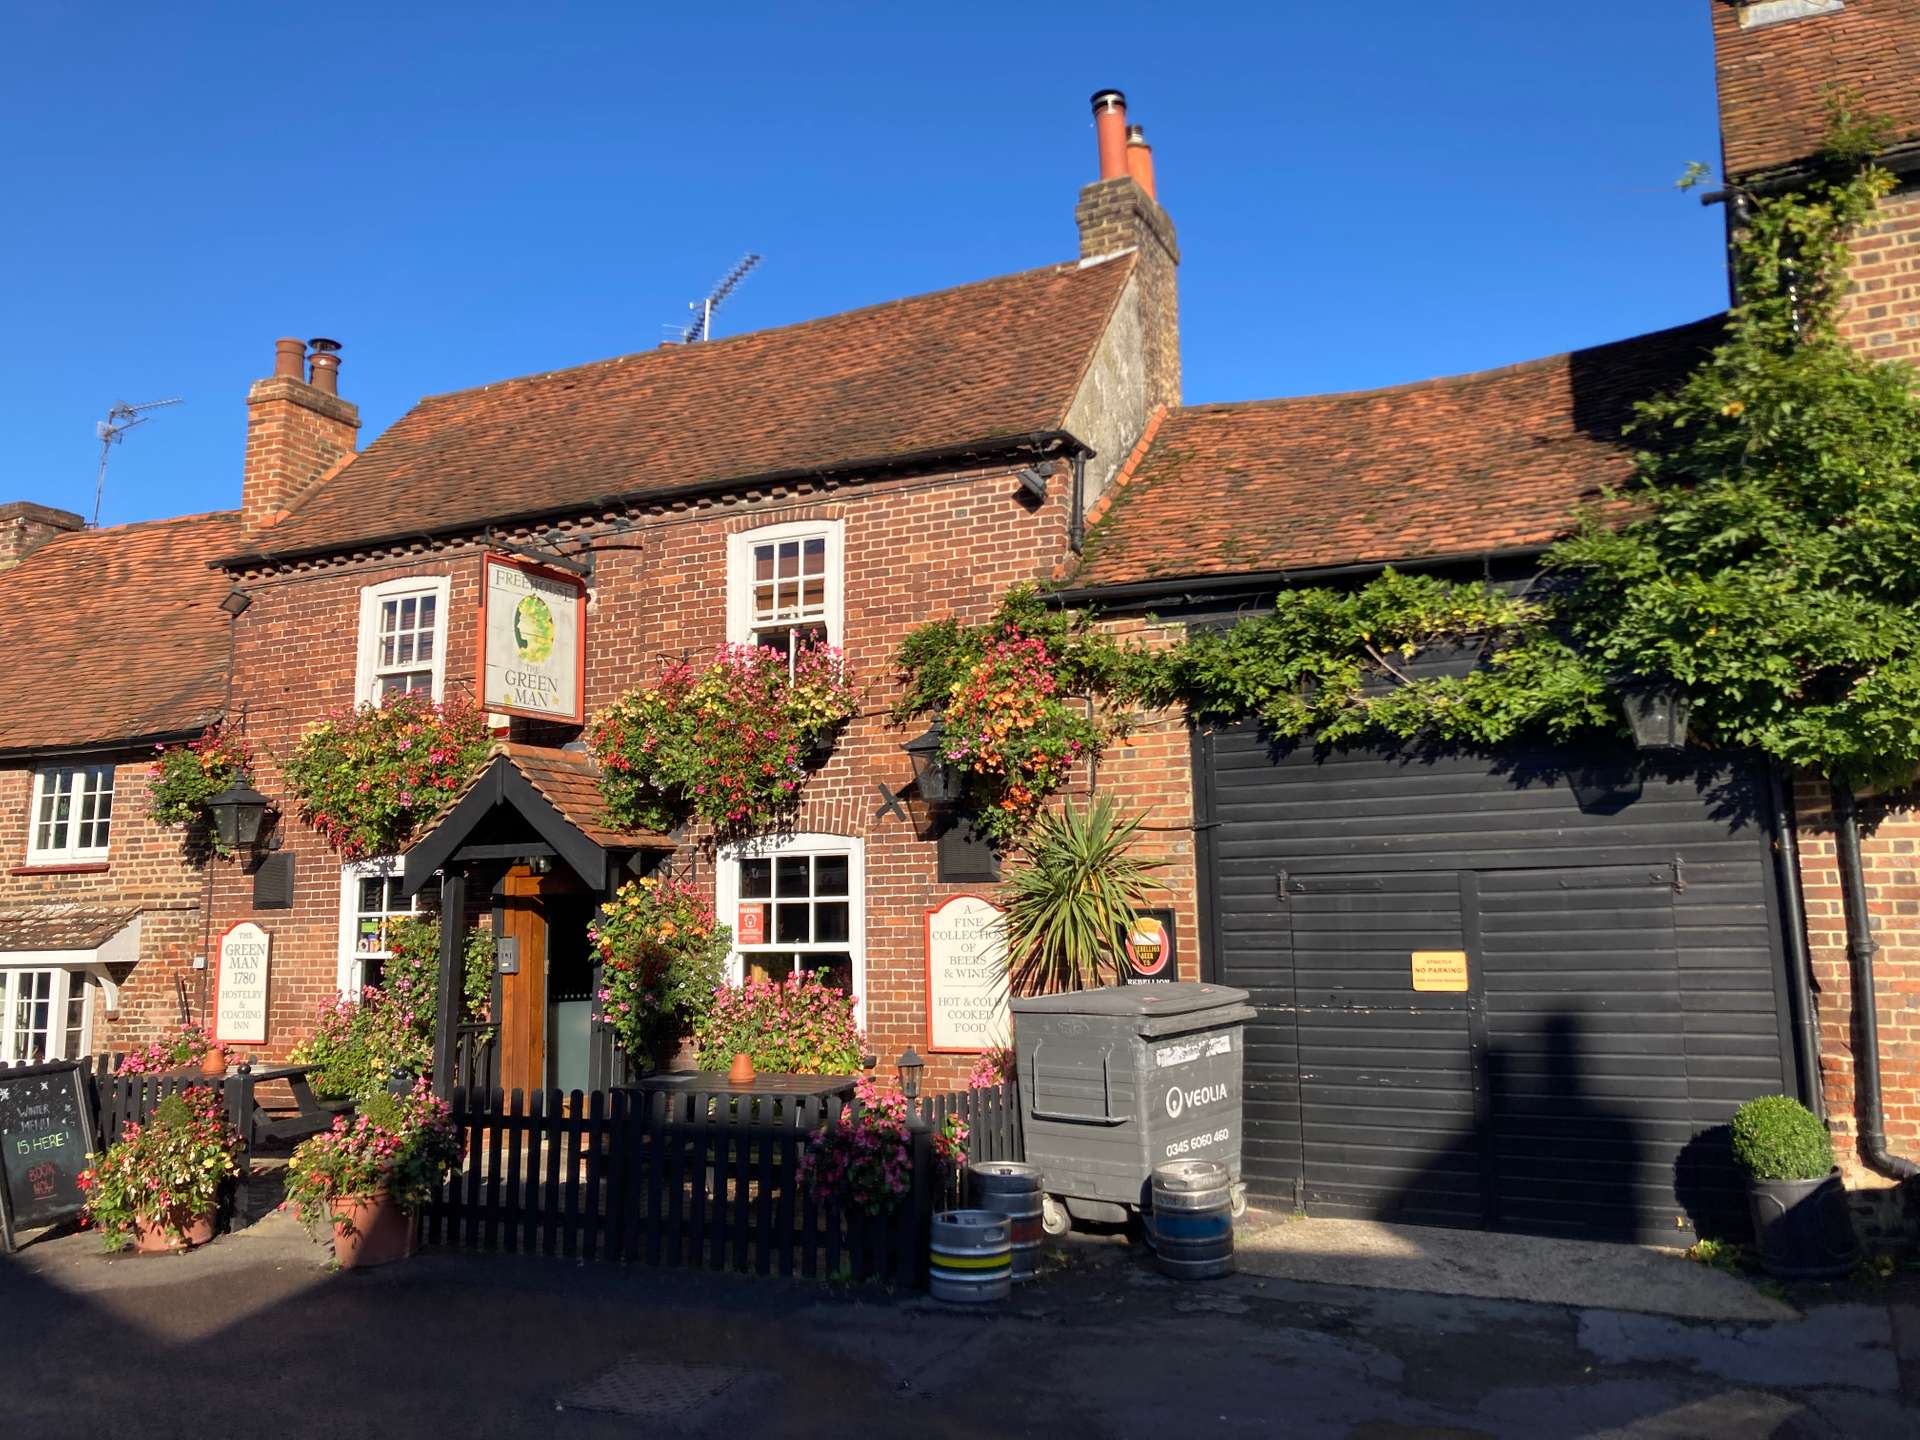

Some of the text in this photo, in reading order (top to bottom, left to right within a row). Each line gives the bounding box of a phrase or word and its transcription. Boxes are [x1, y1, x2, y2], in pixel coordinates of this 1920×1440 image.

[495, 569, 573, 603] FREEHOUSE
[505, 669, 558, 692] GREEN
[514, 688, 548, 707] MAN
[963, 905, 973, 915] A
[954, 917, 984, 927] FINE
[239, 932, 253, 940] THE
[932, 930, 1004, 940] COLLECTION
[225, 943, 266, 957] GREEN
[960, 943, 976, 953] OF
[229, 957, 259, 970] MAN
[949, 956, 987, 965] BEERS
[233, 971, 256, 985] 1780
[944, 969, 995, 979] & WINES
[238, 1001, 246, 1009] &
[938, 997, 1003, 1007] HOT & COLD
[222, 1010, 262, 1020] COACHING
[947, 1010, 995, 1020] COOKED
[233, 1021, 249, 1030] INN
[954, 1023, 987, 1033] FOOD
[1184, 1083, 1229, 1108] VEOLIA
[16, 1103, 50, 1118] WINTER
[20, 1117, 51, 1134] MENU
[16, 1131, 69, 1156] IS HERE!
[1166, 1128, 1229, 1157] 0345 6060 460
[28, 1163, 57, 1182] BOOK
[32, 1180, 55, 1195] NOW
